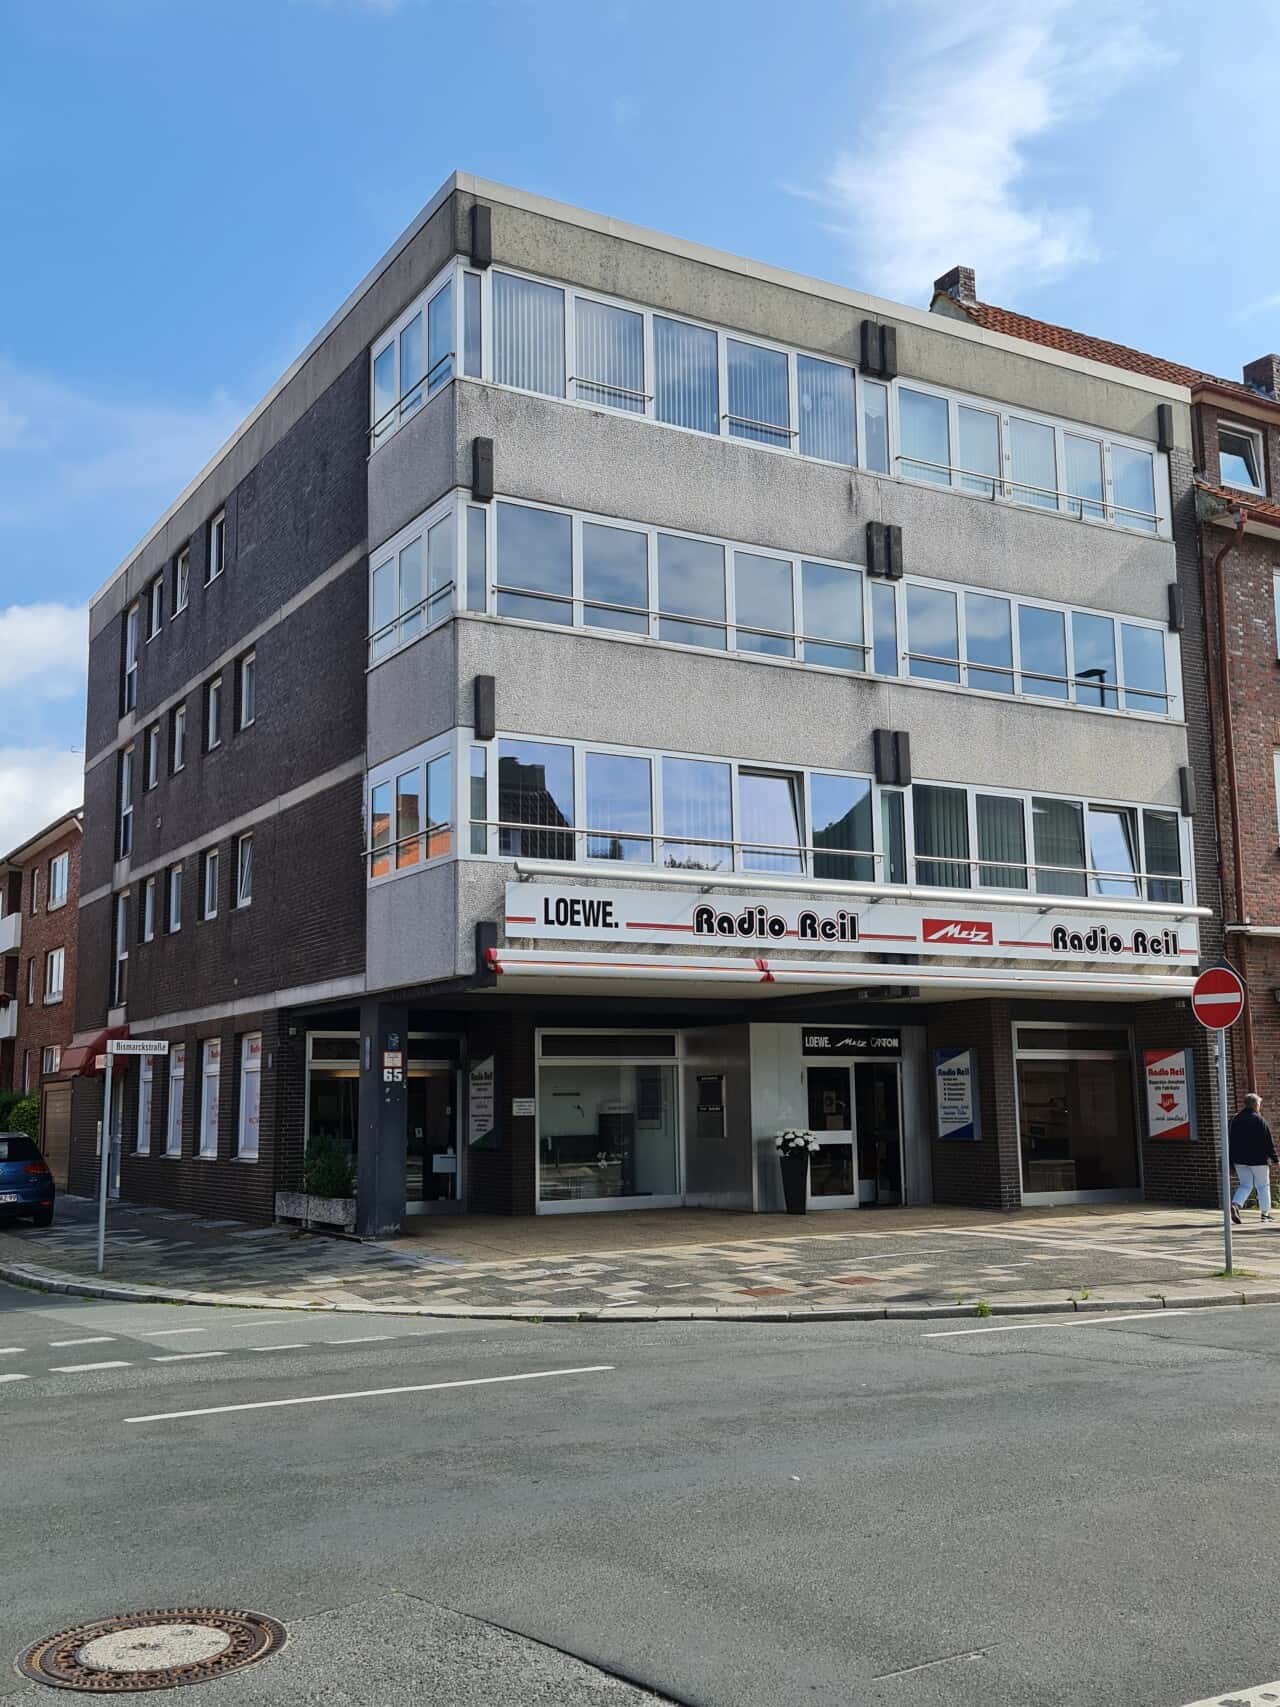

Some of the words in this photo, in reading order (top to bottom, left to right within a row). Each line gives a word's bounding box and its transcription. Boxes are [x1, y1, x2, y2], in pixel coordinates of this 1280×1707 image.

[543, 897, 619, 928] LOEWE.
[694, 904, 787, 939] Radio
[798, 910, 859, 942] Reil
[927, 922, 989, 943] Metz
[1052, 925, 1123, 954] Radio
[1132, 929, 1180, 957] Reil
[116, 1042, 166, 1052] Bismarckstraße
[384, 1068, 402, 1082] 65
